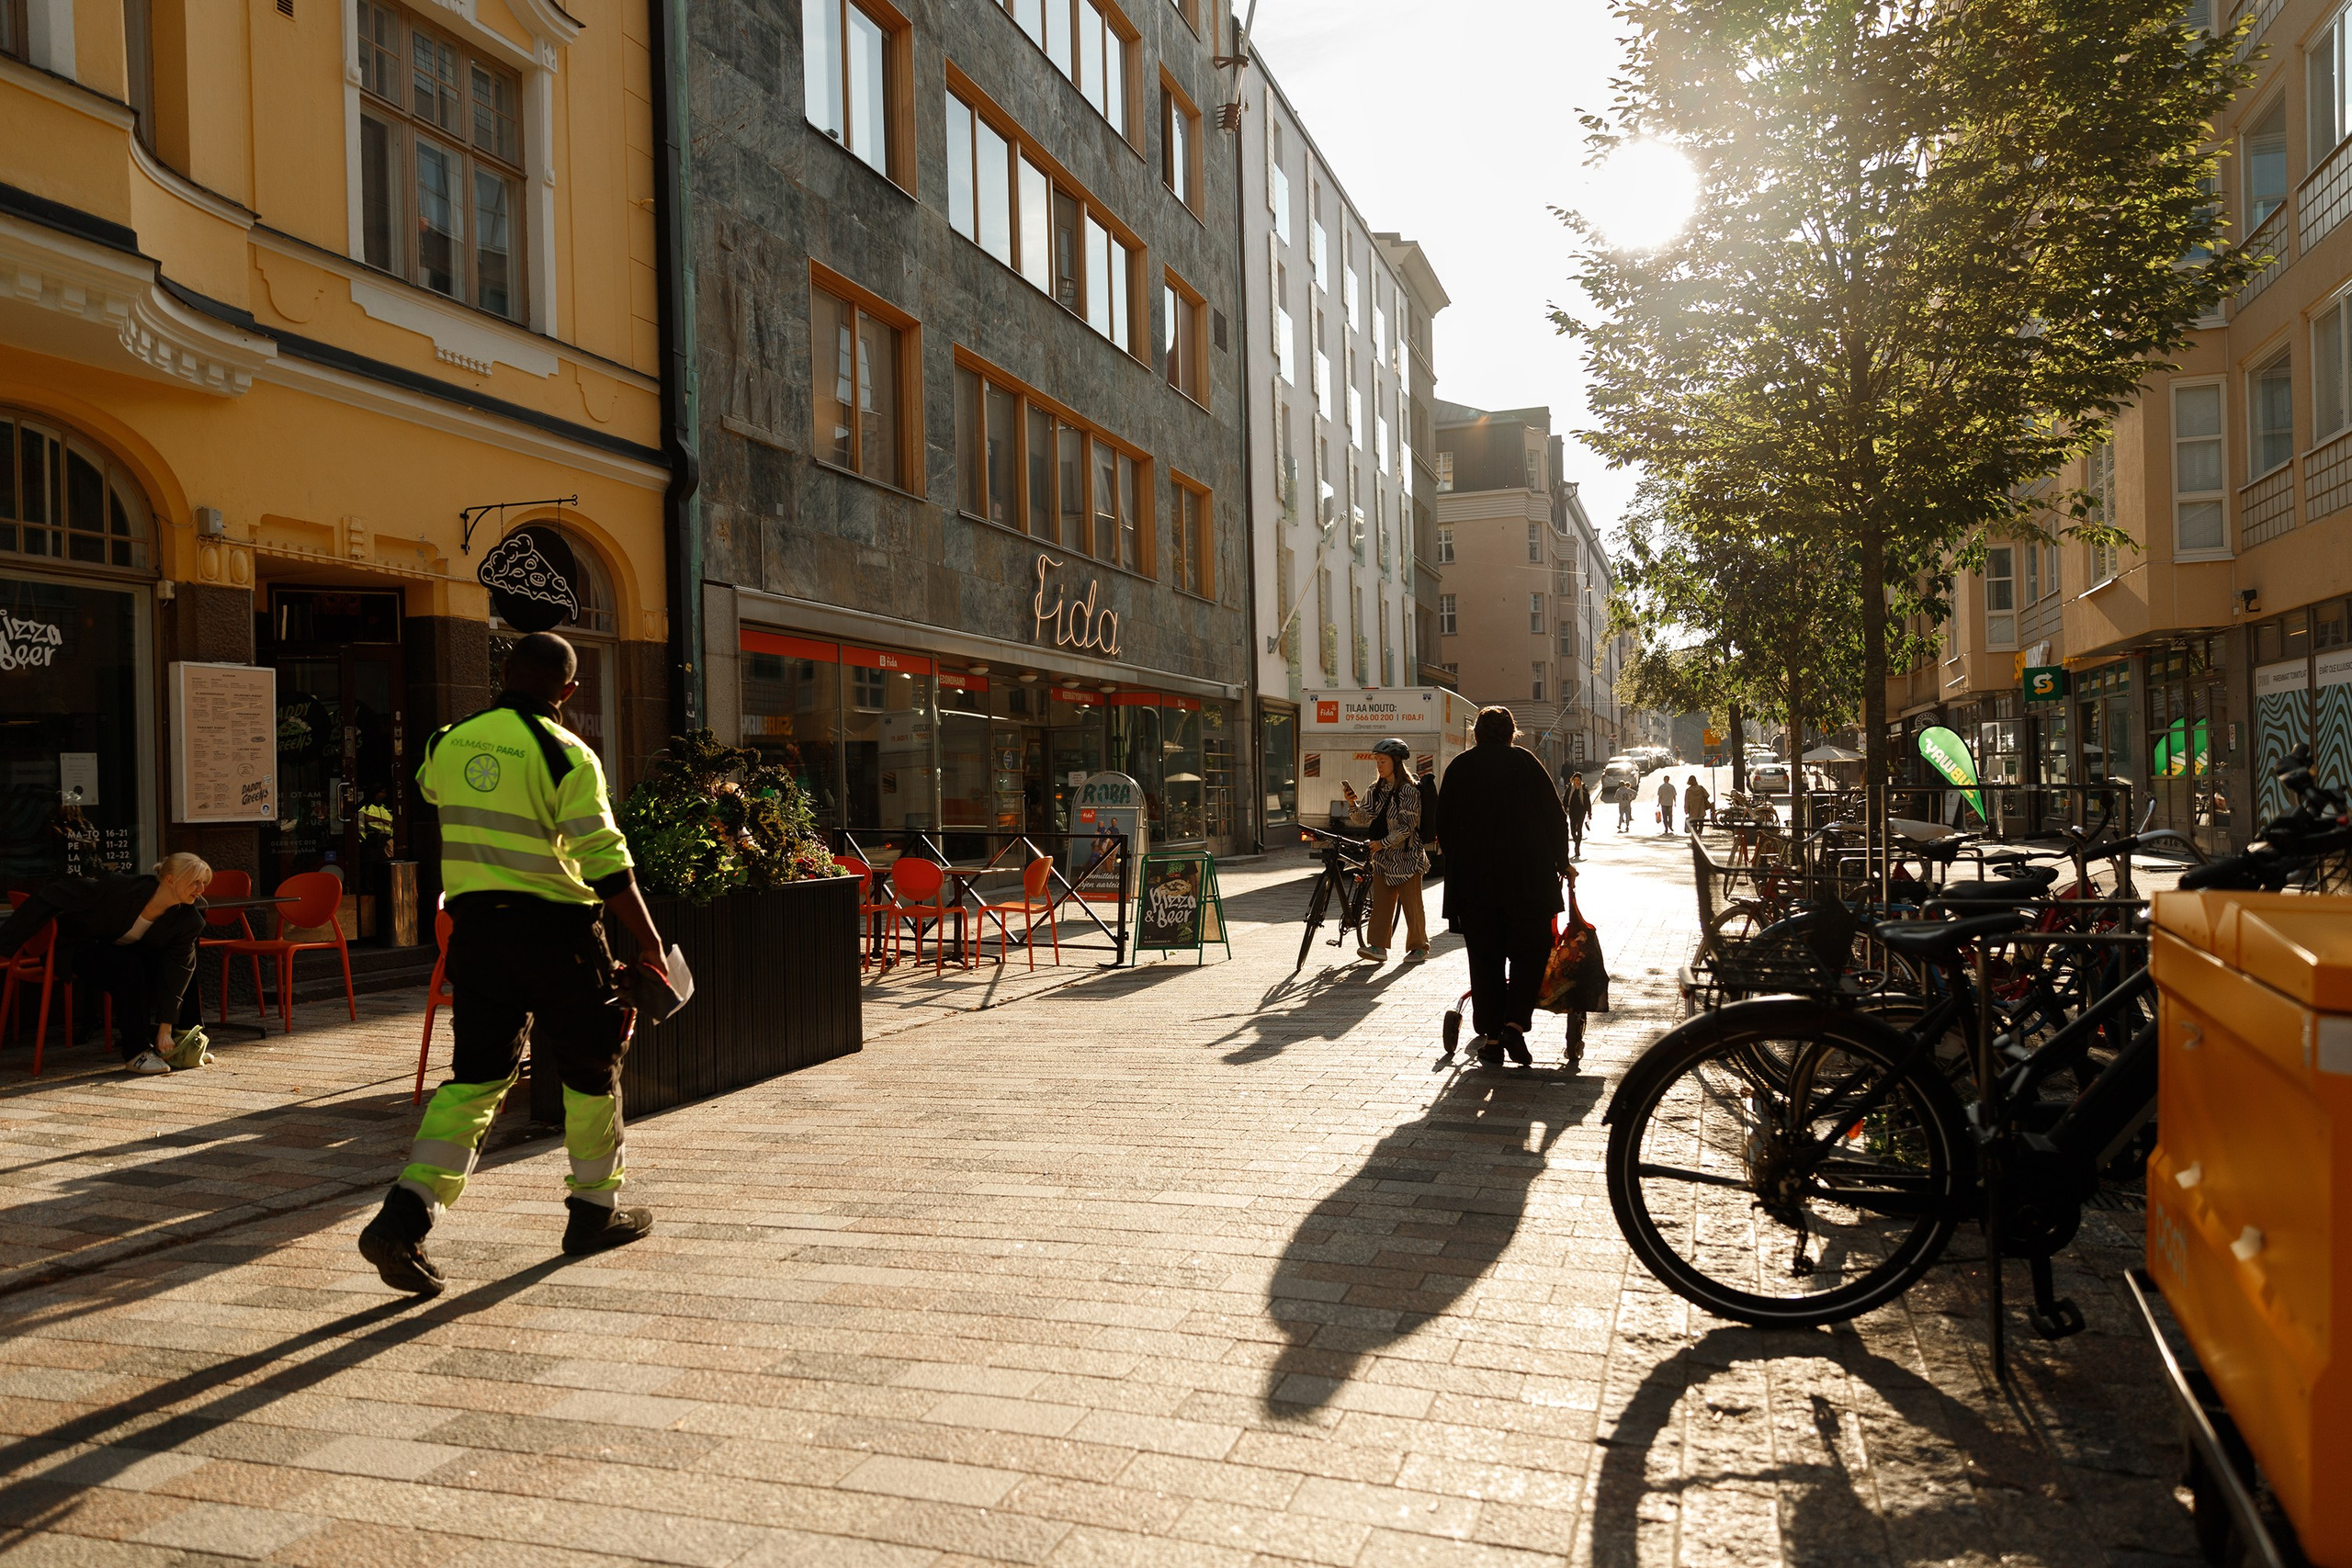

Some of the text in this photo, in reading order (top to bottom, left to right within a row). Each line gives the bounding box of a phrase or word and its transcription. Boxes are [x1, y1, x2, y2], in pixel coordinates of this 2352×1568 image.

[1035, 554, 1121, 655] Fida
[0, 609, 62, 645] izza
[2174, 638, 2188, 647] 23
[939, 674, 966, 686] ECONDHAND
[277, 702, 311, 718] ADDY
[1320, 708, 1334, 716] fida
[1345, 704, 1397, 712] TILAA NOUTO:
[277, 733, 312, 753] REENS
[495, 746, 526, 759] PARAS
[242, 781, 263, 795] DADDY
[1081, 783, 1131, 804] ROBA
[242, 788, 269, 806] GREENS
[67, 842, 79, 851] PE
[68, 853, 80, 862] LA
[1149, 887, 1197, 913] Pizza
[1144, 904, 1193, 929] & Beer
